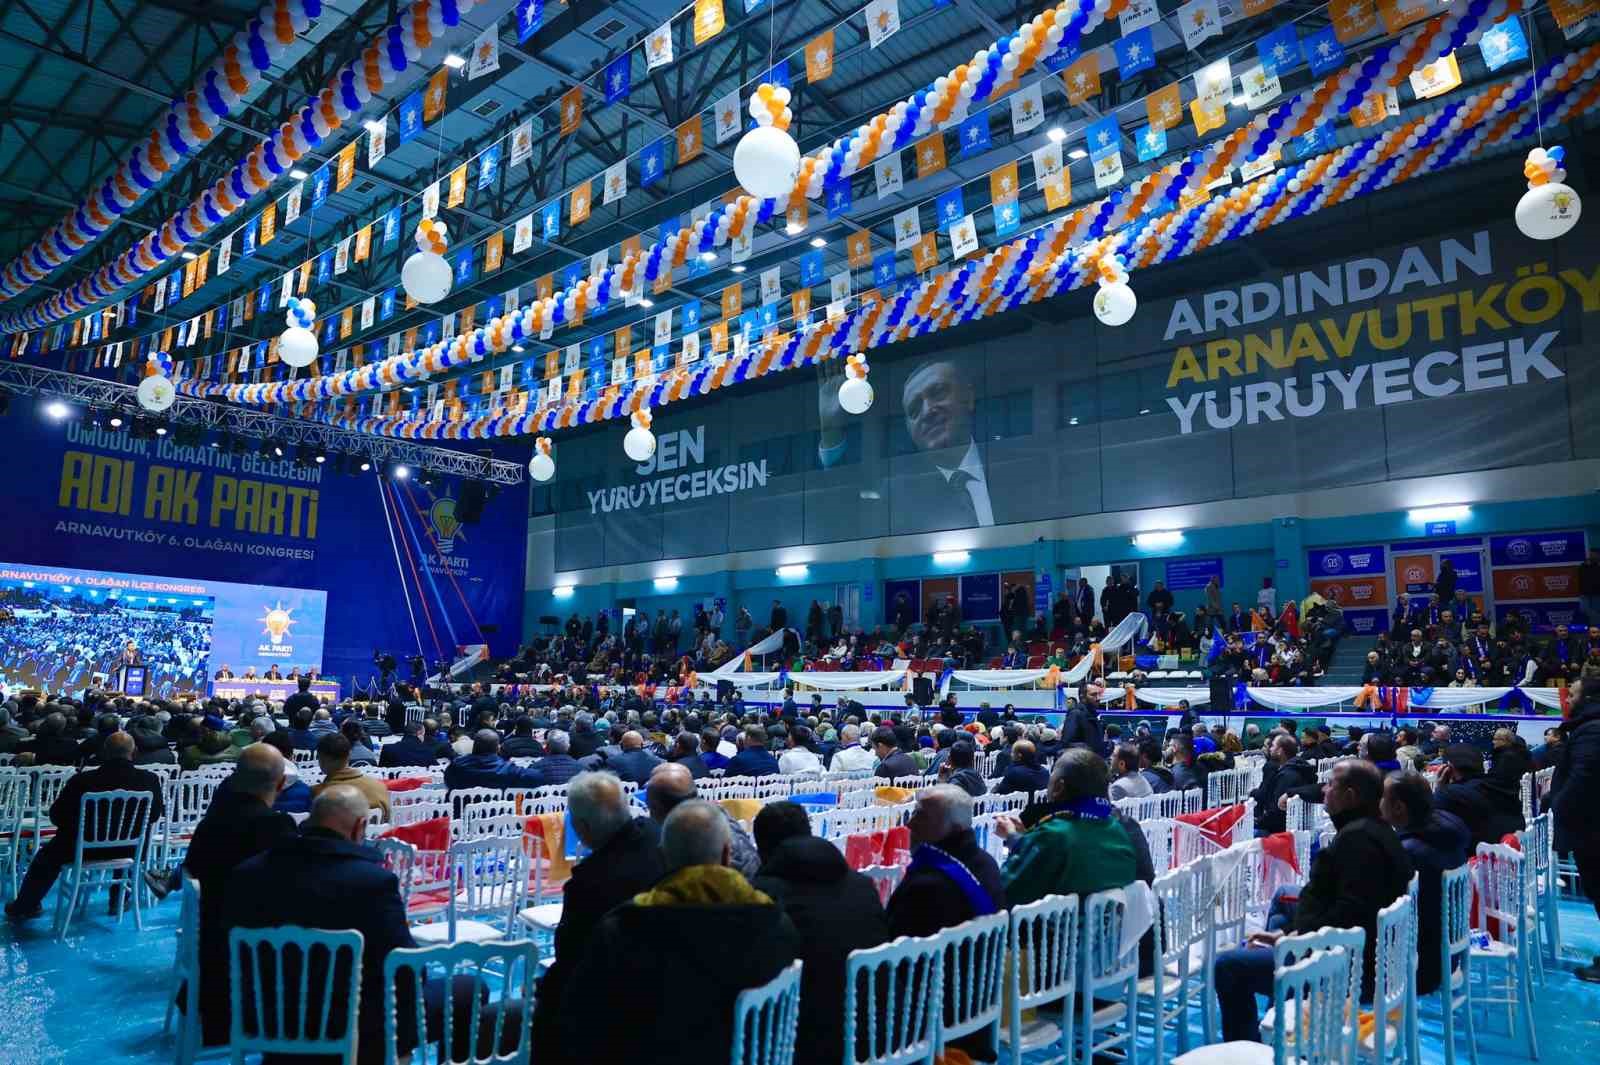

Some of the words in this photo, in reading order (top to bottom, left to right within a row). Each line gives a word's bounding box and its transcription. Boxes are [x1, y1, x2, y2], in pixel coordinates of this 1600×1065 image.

[1163, 231, 1493, 341] ARDINDAN
[1166, 262, 1600, 389] ARNAVUTKÖY
[1165, 330, 1565, 435] YÜRÜYECEK
[58, 450, 135, 516] ADI
[144, 464, 202, 525] AK
[209, 474, 320, 539] PARTİ
[587, 459, 767, 515] YÜRÜYECEKSİN
[55, 520, 167, 545] ARNAVUTKÖY
[168, 536, 180, 546] 6.
[184, 536, 244, 554] OLAĞAN
[247, 543, 315, 561] KONGRESİ
